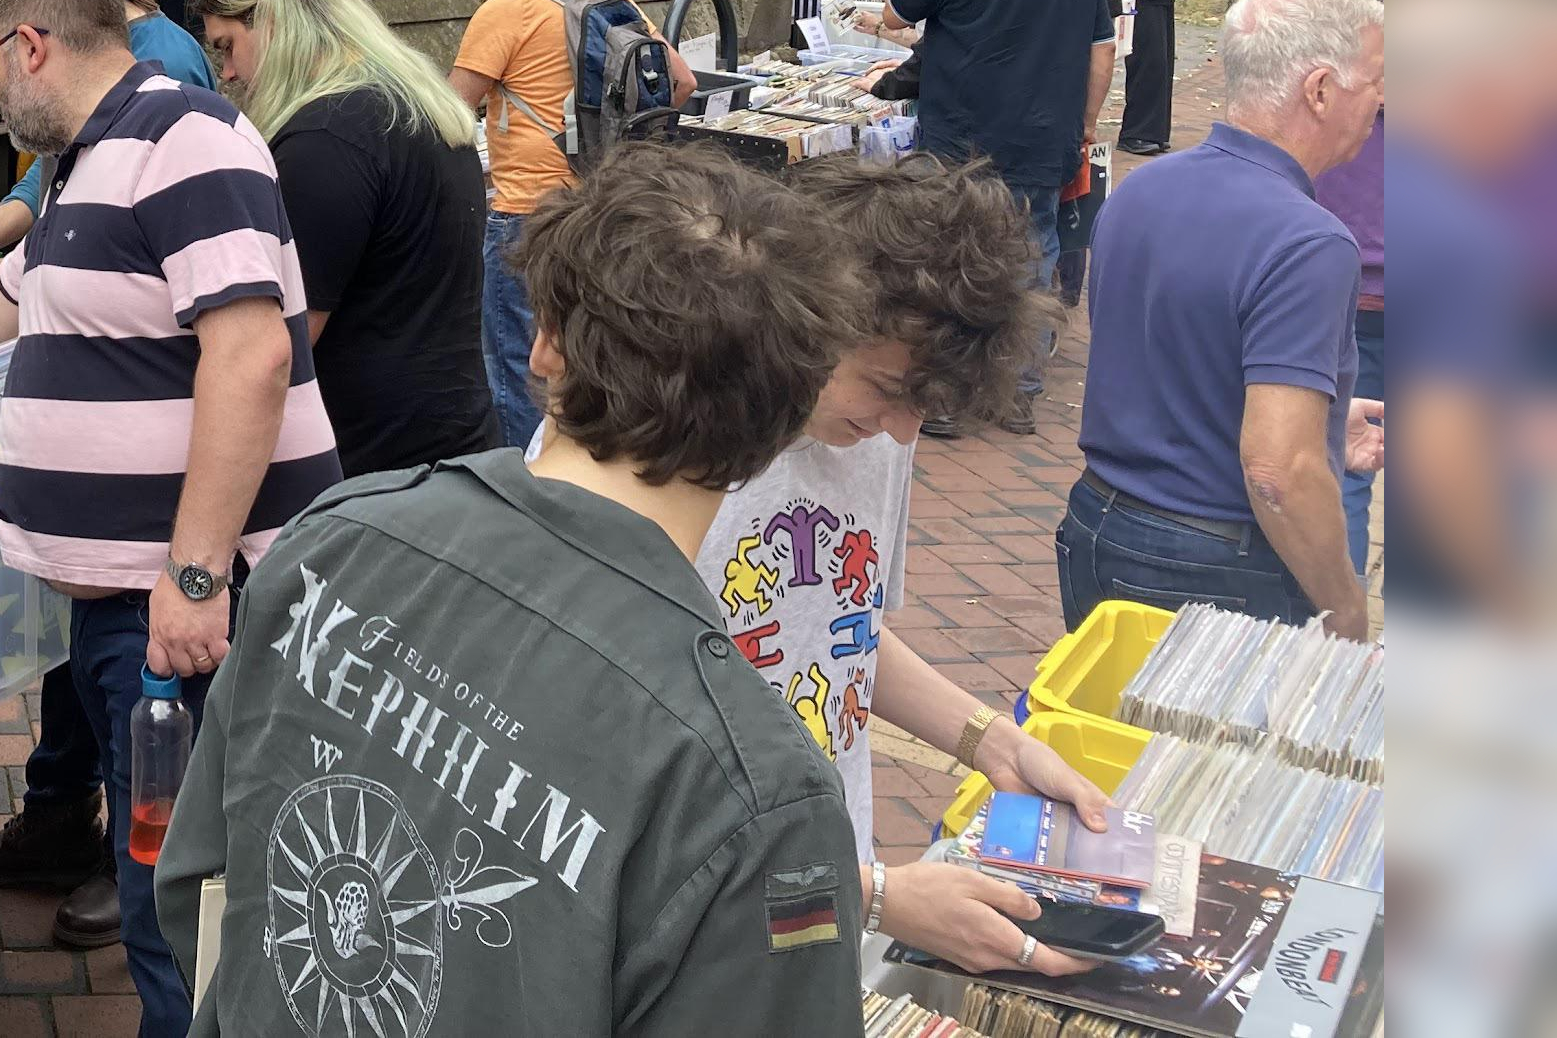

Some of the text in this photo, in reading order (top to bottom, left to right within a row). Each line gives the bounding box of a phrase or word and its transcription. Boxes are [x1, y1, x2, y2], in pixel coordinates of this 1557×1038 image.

[270, 562, 607, 893] NEPHILIM
[454, 682, 484, 709] OF
[484, 702, 524, 741] THE
